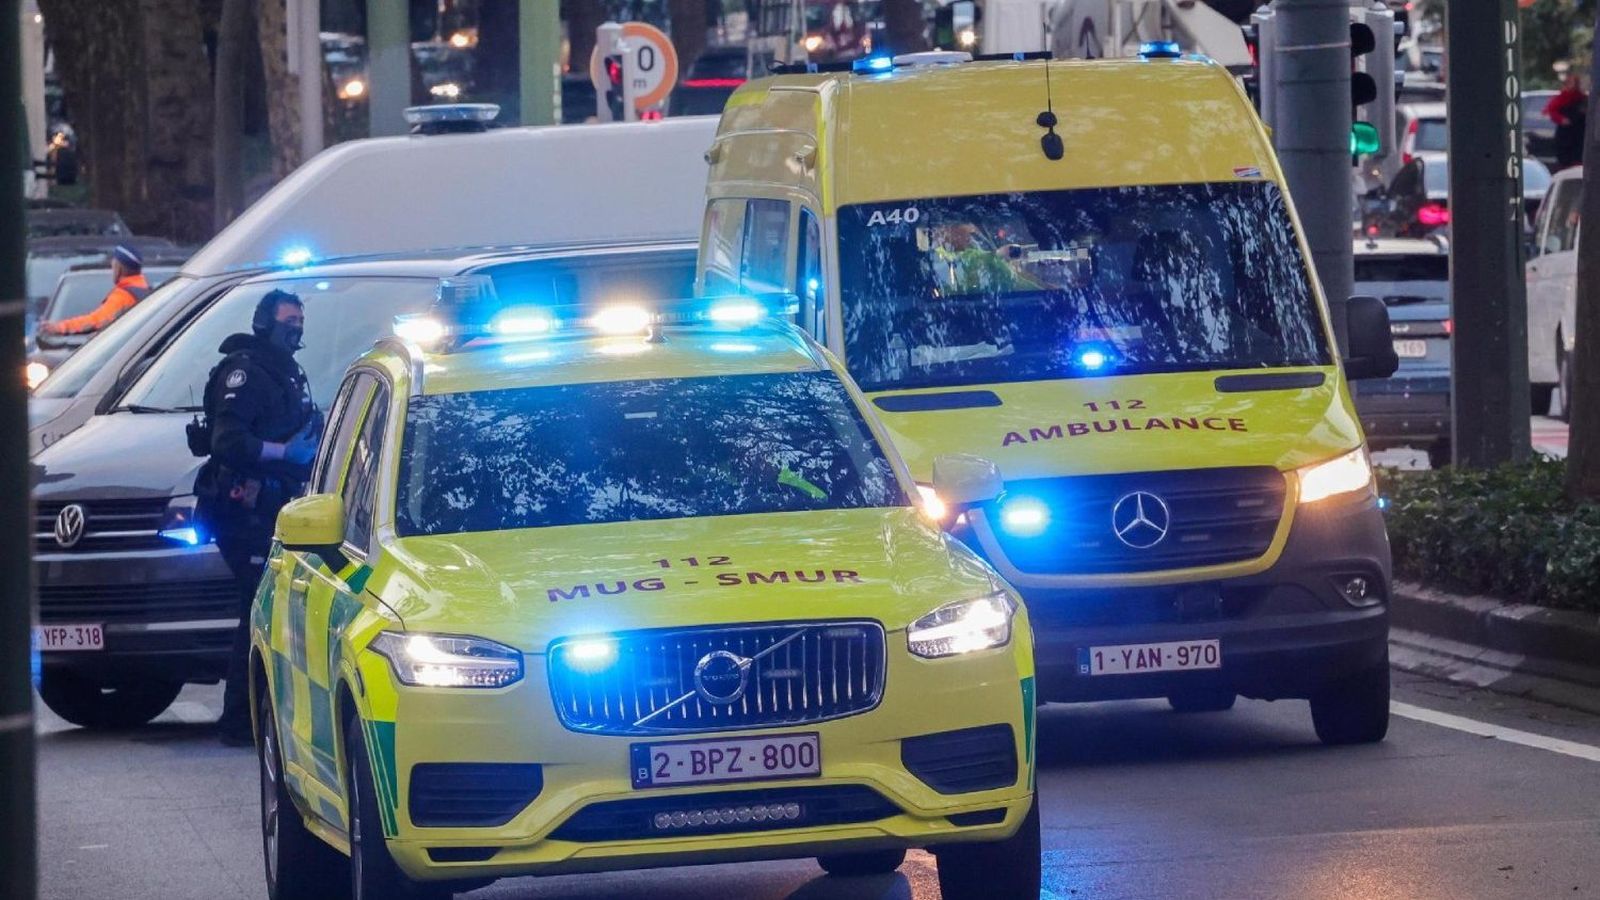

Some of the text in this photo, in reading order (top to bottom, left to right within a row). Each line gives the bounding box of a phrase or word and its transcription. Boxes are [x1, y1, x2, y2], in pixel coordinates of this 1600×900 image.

[866, 207, 920, 227] A40
[1083, 399, 1147, 412] 112
[1002, 417, 1249, 447] AMBULANCE
[652, 556, 733, 568] 112
[547, 578, 666, 603] MUG
[715, 569, 864, 587] SMUR
[1094, 644, 1217, 671] 1-YAN-970
[654, 742, 815, 779] 2-BPZ-800
